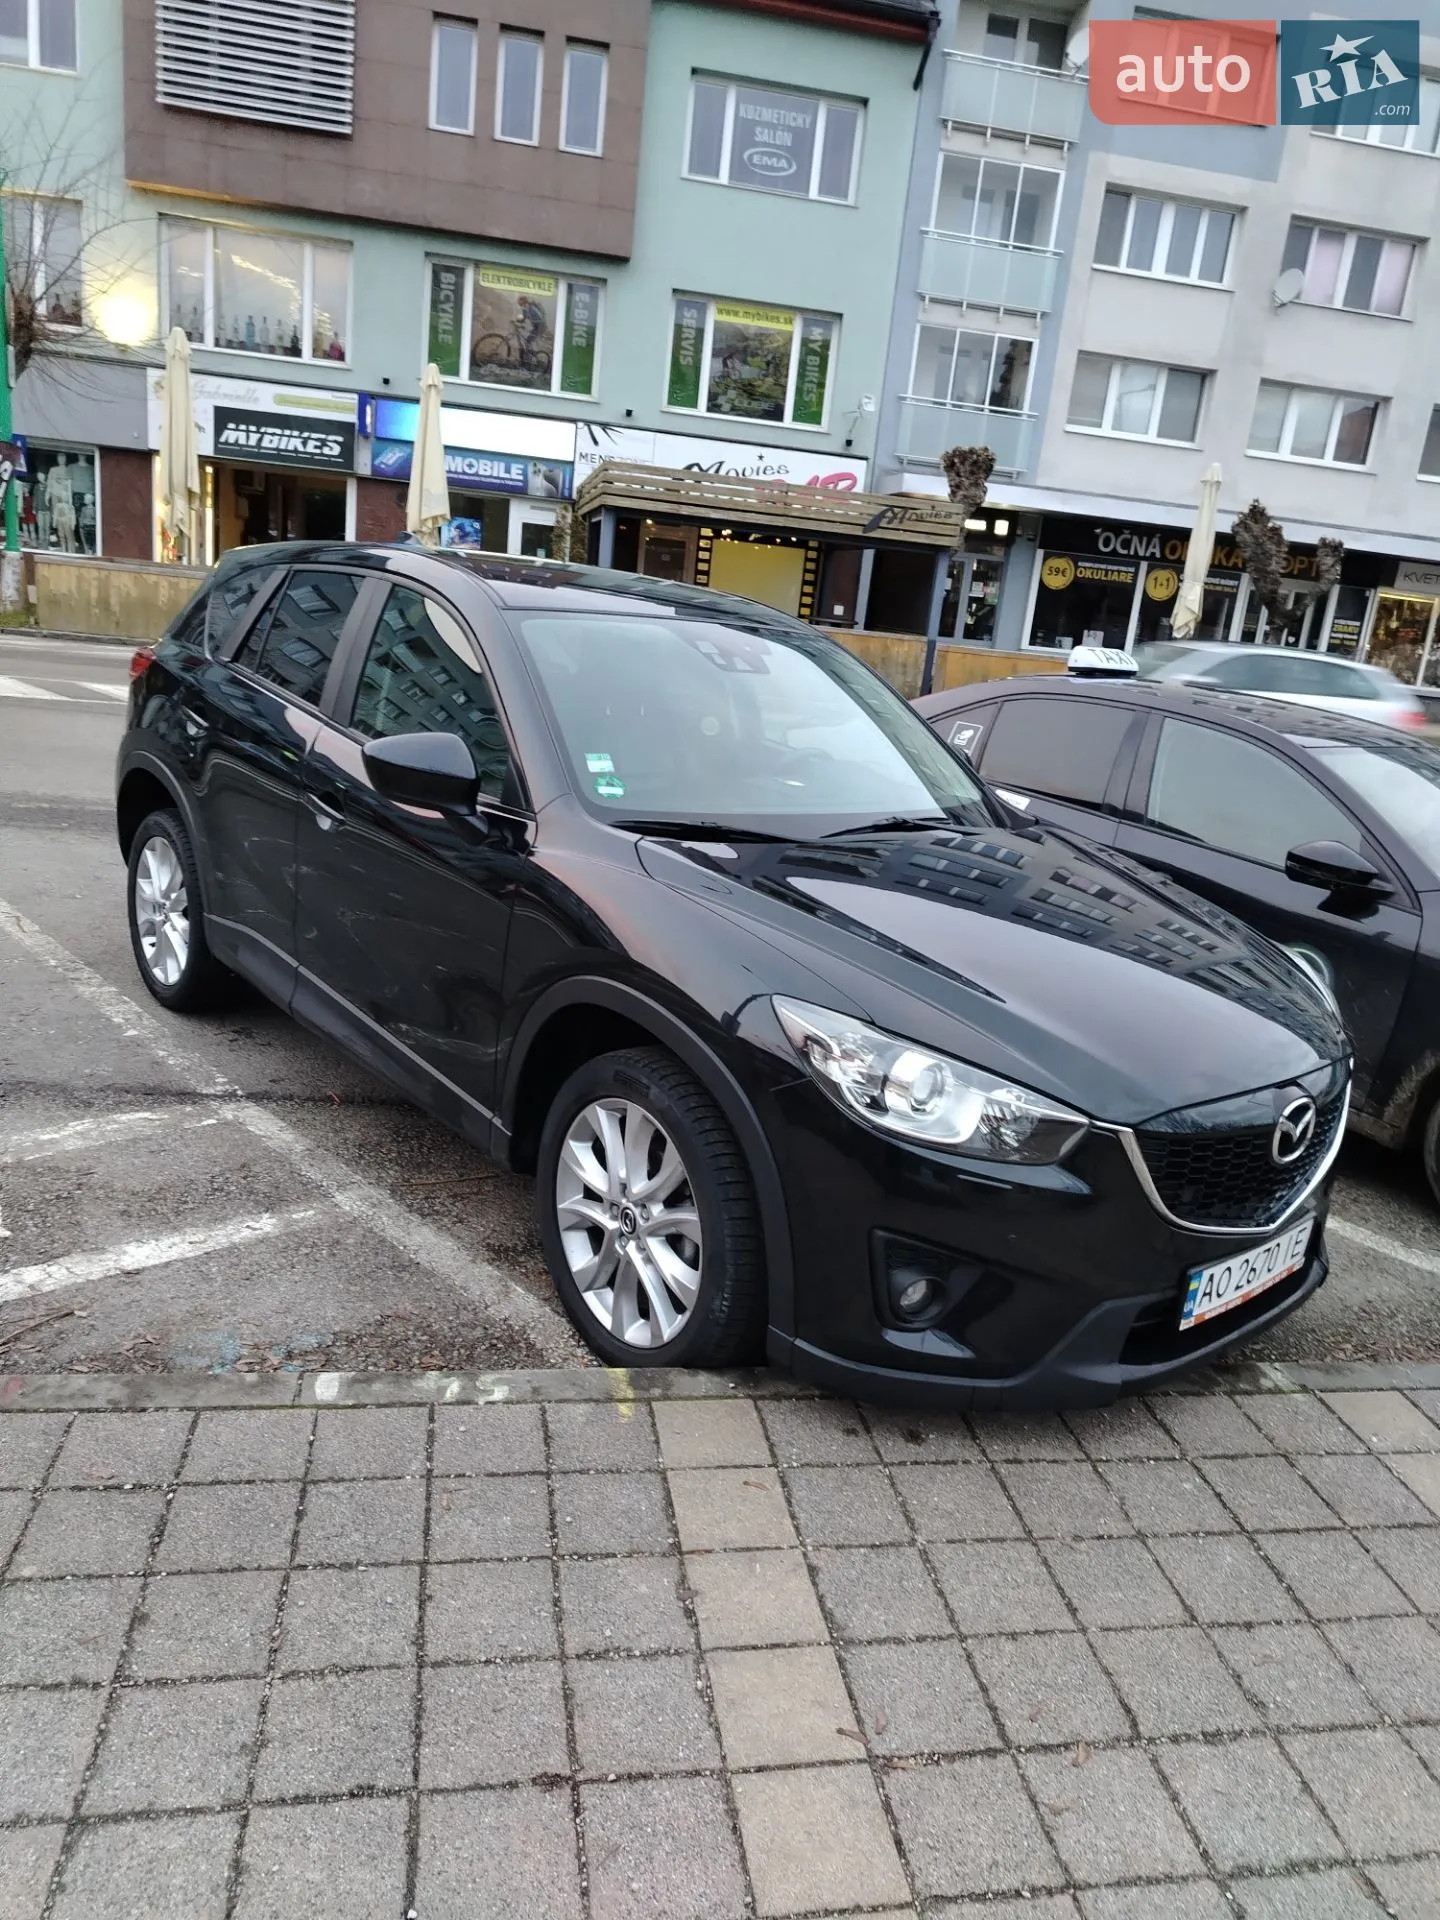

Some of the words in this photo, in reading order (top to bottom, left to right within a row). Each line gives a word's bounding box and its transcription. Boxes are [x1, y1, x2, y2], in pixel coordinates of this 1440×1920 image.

[752, 154, 790, 170] EMA
[481, 271, 553, 293] ELEKTROBICYKLE
[438, 271, 456, 345] BICYKLE
[572, 292, 590, 348] E-BIKE
[680, 307, 698, 367] SERVIS
[808, 326, 824, 353] MY
[803, 354, 821, 402] BIKES
[218, 422, 345, 457] MYBIKES
[445, 454, 524, 480] MOBILE
[1096, 529, 1162, 558] OČNÁ
[1047, 565, 1069, 578] 59€
[1076, 566, 1134, 584] OKULIARE
[1087, 648, 1134, 665] TAXI
[1198, 1265, 1232, 1307] AO
[1234, 1241, 1281, 1292] 2670
